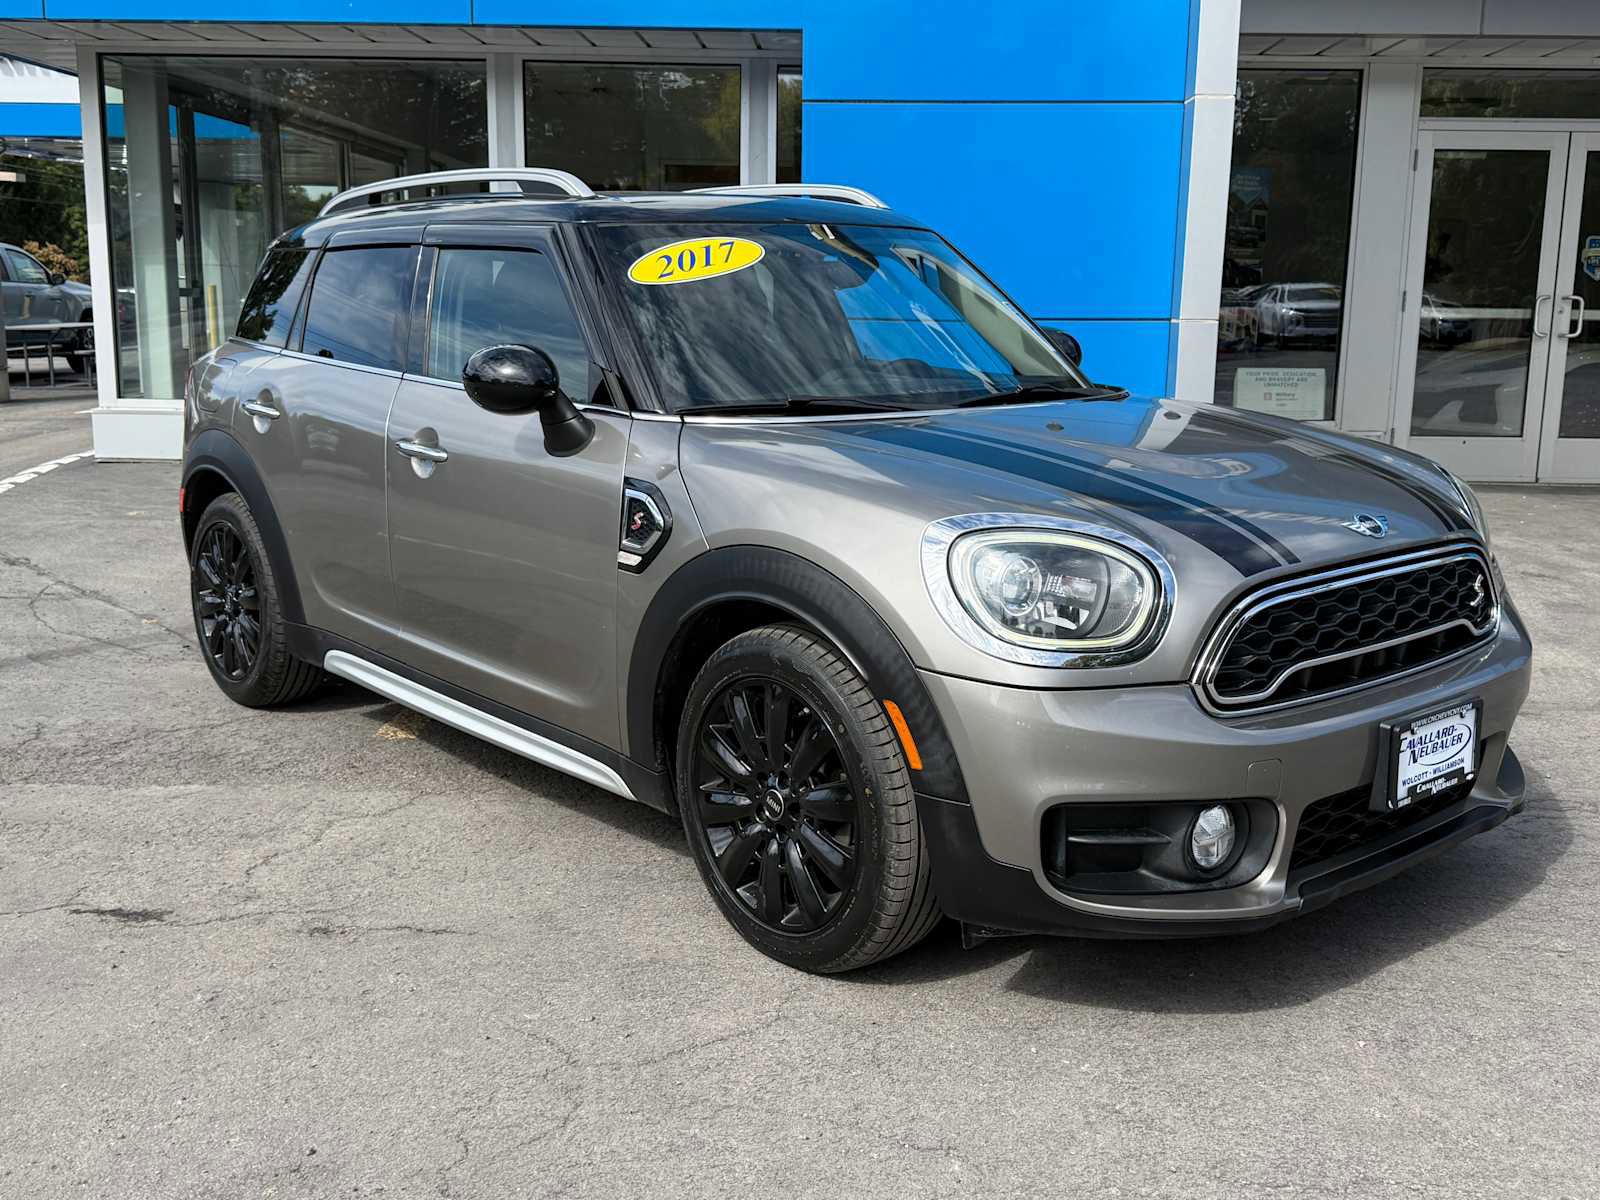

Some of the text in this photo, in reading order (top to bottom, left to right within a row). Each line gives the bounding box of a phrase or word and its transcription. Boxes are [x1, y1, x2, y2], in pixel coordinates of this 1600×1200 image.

[656, 241, 735, 279] 2017
[1408, 733, 1464, 766] NEUBAUER
[1402, 771, 1428, 787] WOLCOTT
[766, 795, 780, 813] MINI
